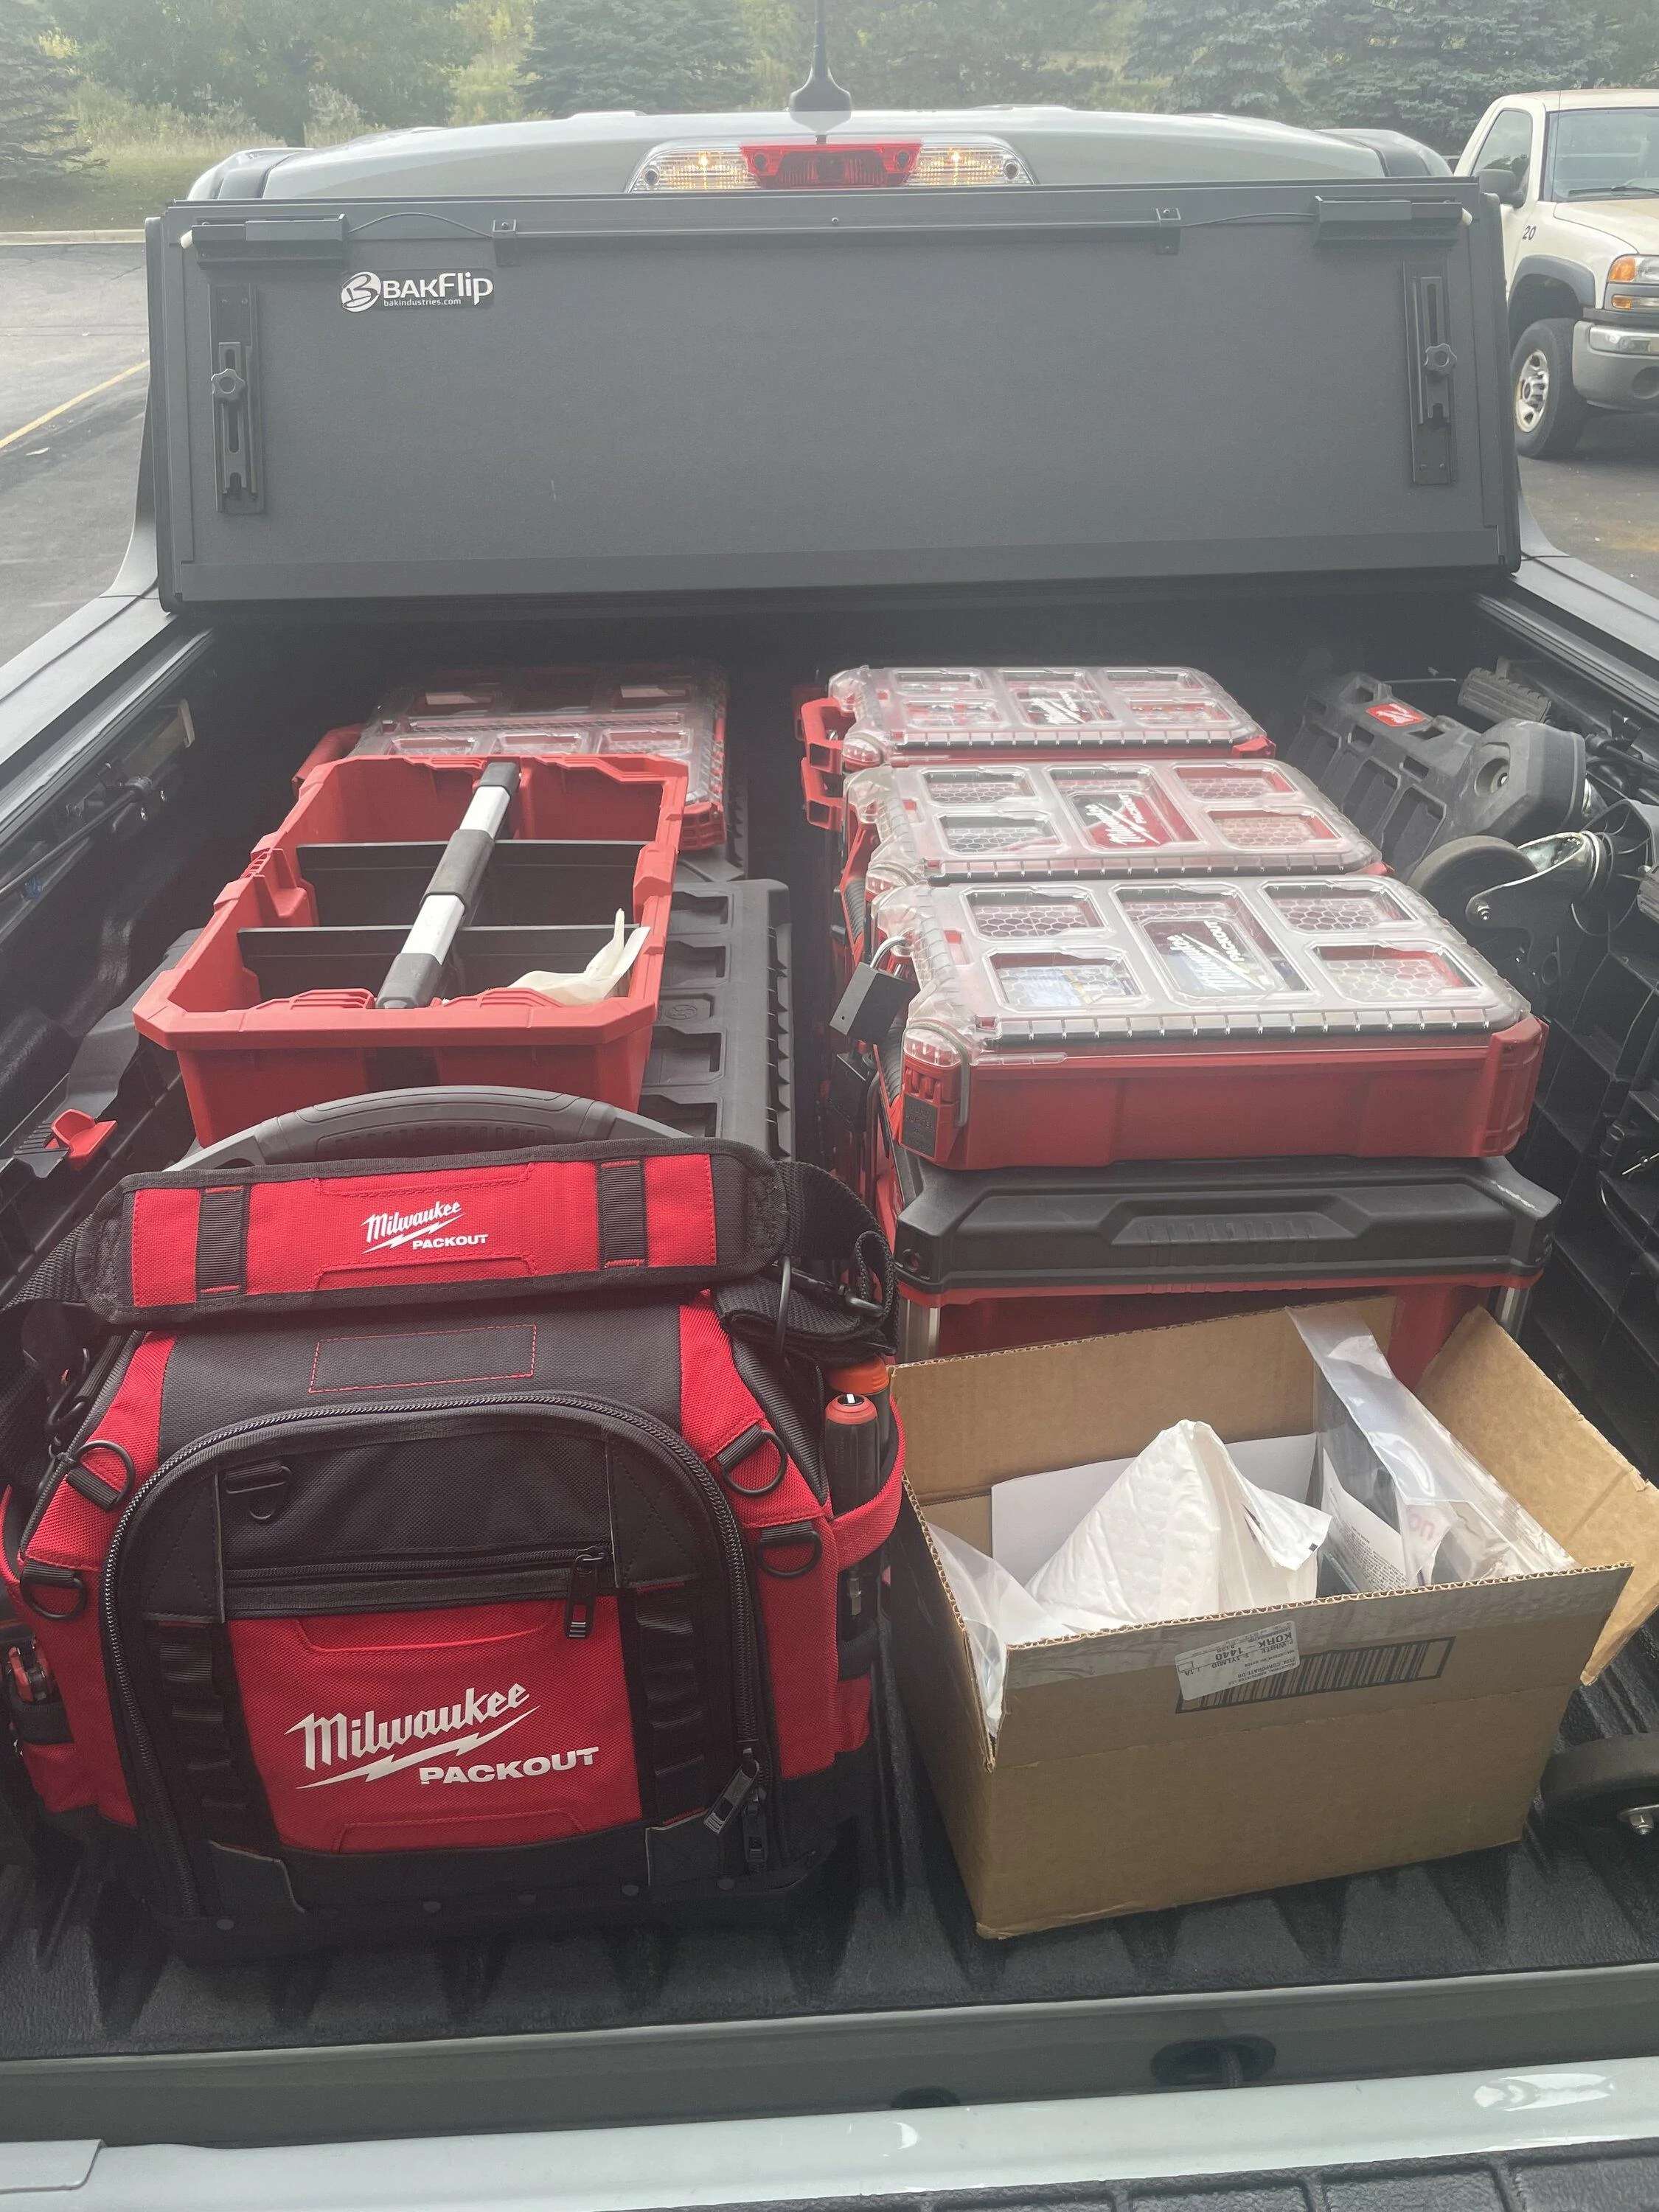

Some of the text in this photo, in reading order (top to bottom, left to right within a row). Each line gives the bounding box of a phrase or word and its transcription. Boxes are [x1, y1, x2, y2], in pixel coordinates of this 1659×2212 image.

[1522, 226, 1537, 240] 20
[383, 271, 493, 305] BAKFlip
[383, 298, 462, 307] bakindustries.com
[1203, 920, 1245, 961] PACKOUT
[360, 1200, 462, 1244] Milwaukee
[412, 1234, 489, 1250] PACKOUT
[1258, 1632, 1292, 1648] KORK
[1215, 1647, 1243, 1660] 1440
[284, 1683, 530, 1771] Milwaukee
[419, 1746, 599, 1785] PACKOUT
